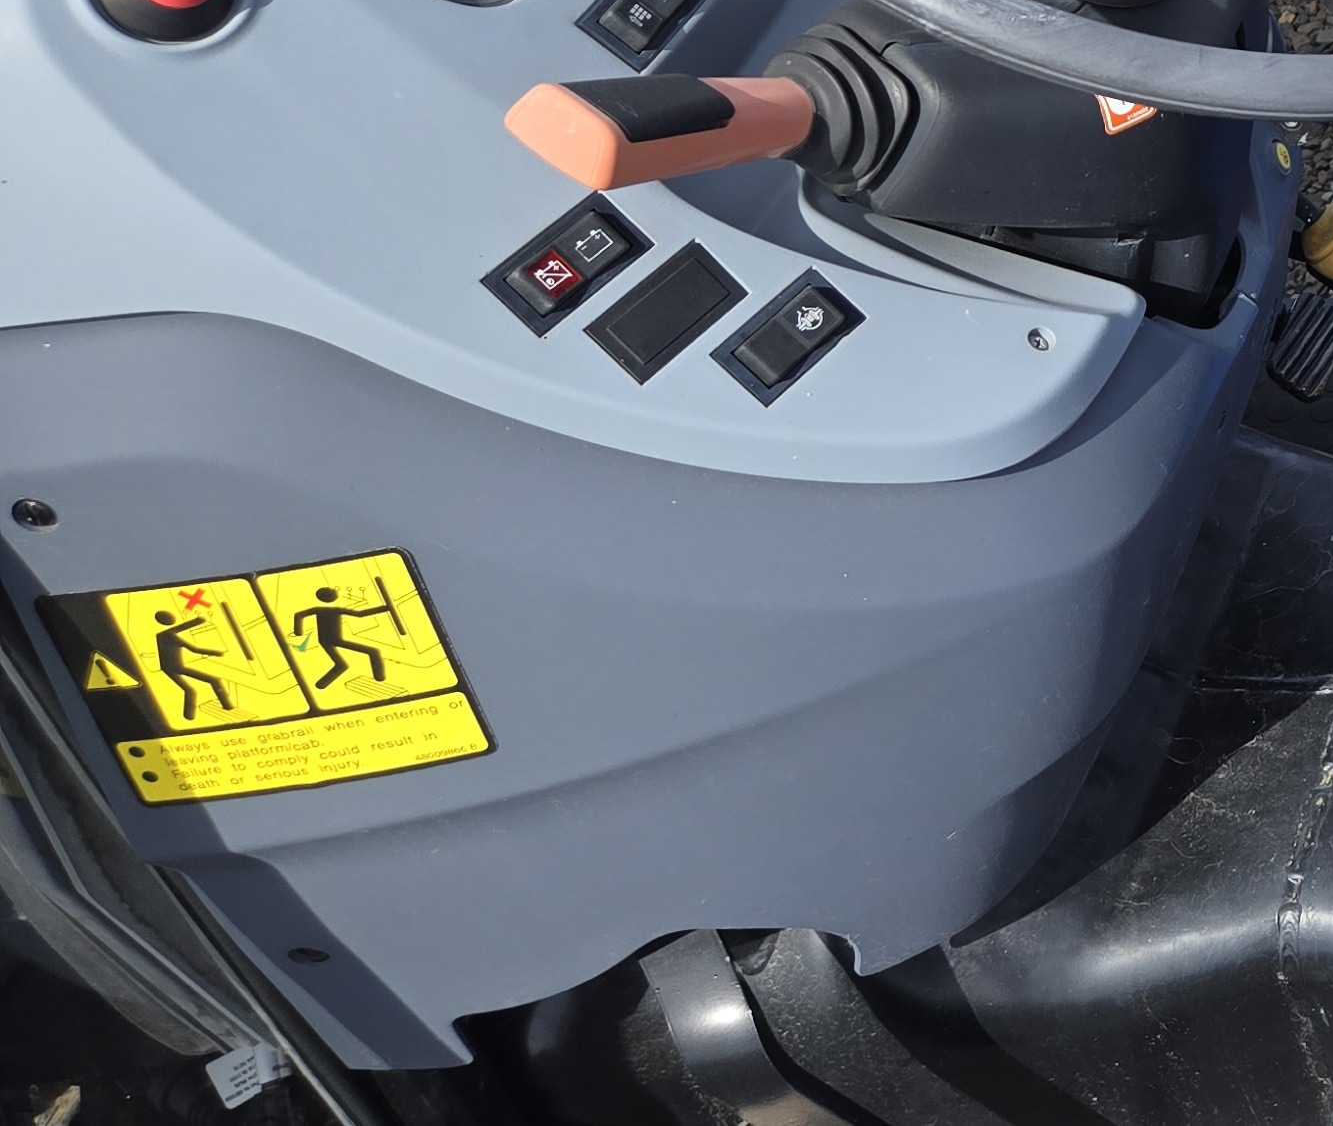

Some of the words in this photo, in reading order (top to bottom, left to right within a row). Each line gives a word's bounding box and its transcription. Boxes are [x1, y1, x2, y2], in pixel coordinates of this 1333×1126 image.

[160, 741, 210, 754] Always
[220, 738, 247, 747] use
[258, 726, 314, 744] grabrail
[324, 719, 365, 732] when
[375, 705, 439, 724] entering
[449, 700, 464, 710] or
[165, 753, 219, 767] leaving
[227, 739, 325, 760] platform/cab.
[172, 765, 222, 779] Failure
[231, 763, 246, 771] to
[257, 754, 308, 770] comply
[320, 745, 360, 760] could
[371, 736, 414, 751] result
[423, 731, 438, 742] in
[179, 779, 220, 791] death
[230, 777, 245, 785] or
[255, 767, 309, 782] serious
[319, 759, 364, 775] injury.
